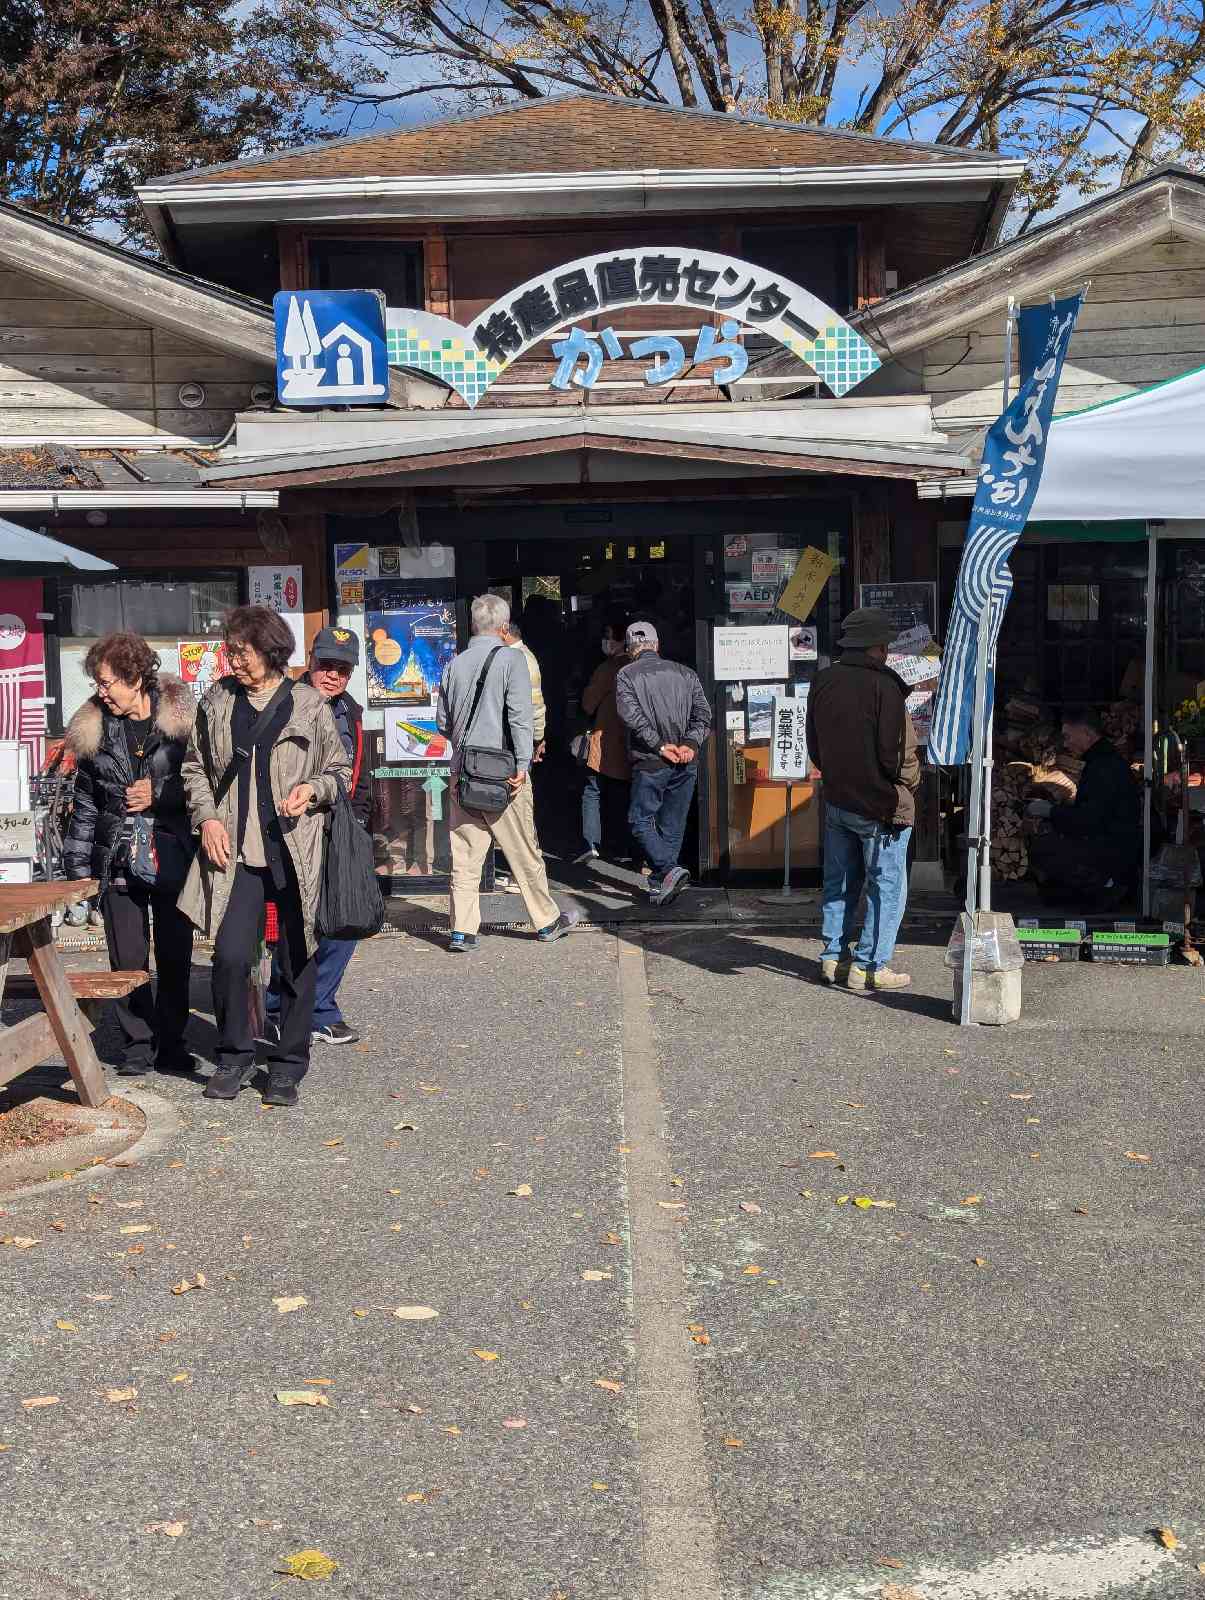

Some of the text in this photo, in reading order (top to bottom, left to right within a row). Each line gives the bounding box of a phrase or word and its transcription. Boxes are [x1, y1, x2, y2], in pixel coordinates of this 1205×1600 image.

[473, 255, 821, 363] 特産品直売センター
[550, 321, 751, 390] かつら
[743, 591, 771, 601] AED
[182, 645, 203, 659] STOP
[794, 705, 806, 768] いらっしゃいませ
